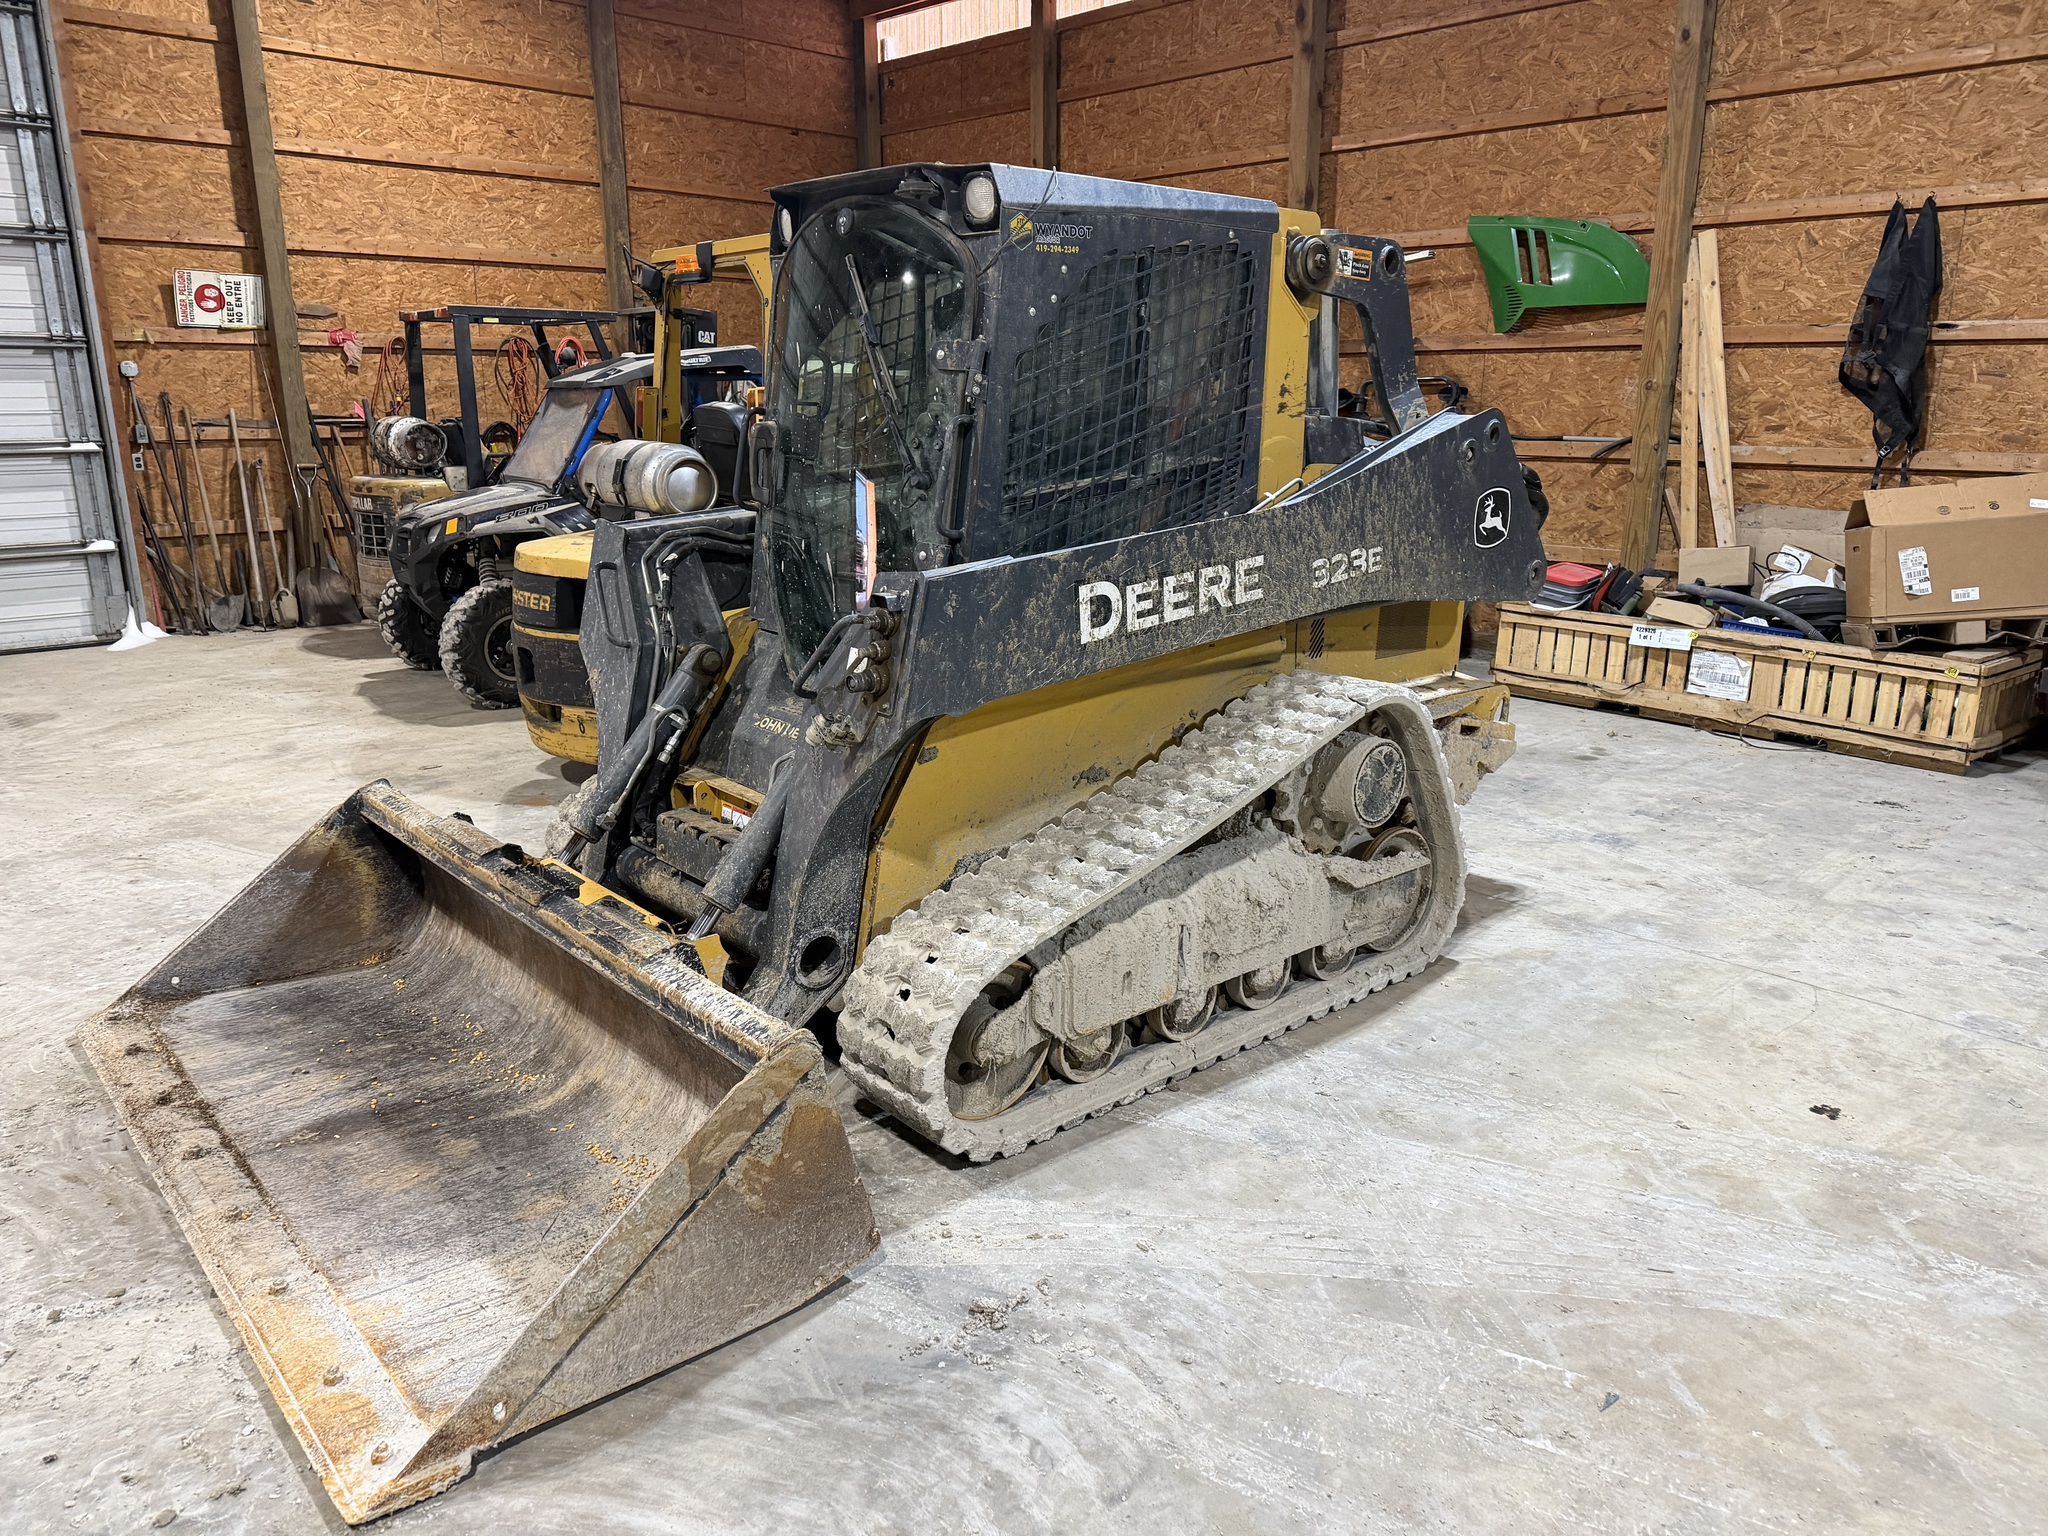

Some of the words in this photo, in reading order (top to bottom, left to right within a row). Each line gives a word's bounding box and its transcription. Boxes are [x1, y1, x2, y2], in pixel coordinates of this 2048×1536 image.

[1034, 223, 1093, 239] WYANDOT
[1035, 244, 1080, 254] 419-294-2349
[177, 270, 186, 297] PELIGRO
[185, 271, 193, 296] PESTICIDAS
[225, 280, 233, 297] OUT
[233, 280, 243, 307] ENTRE
[178, 299, 189, 322] DANGER
[187, 299, 195, 322] PESTICIDES
[226, 301, 235, 323] KEEP
[235, 309, 244, 323] NO
[698, 330, 716, 344] CAT
[495, 502, 549, 523] 800
[1311, 546, 1384, 589] 323E
[1078, 554, 1265, 645] DEERE
